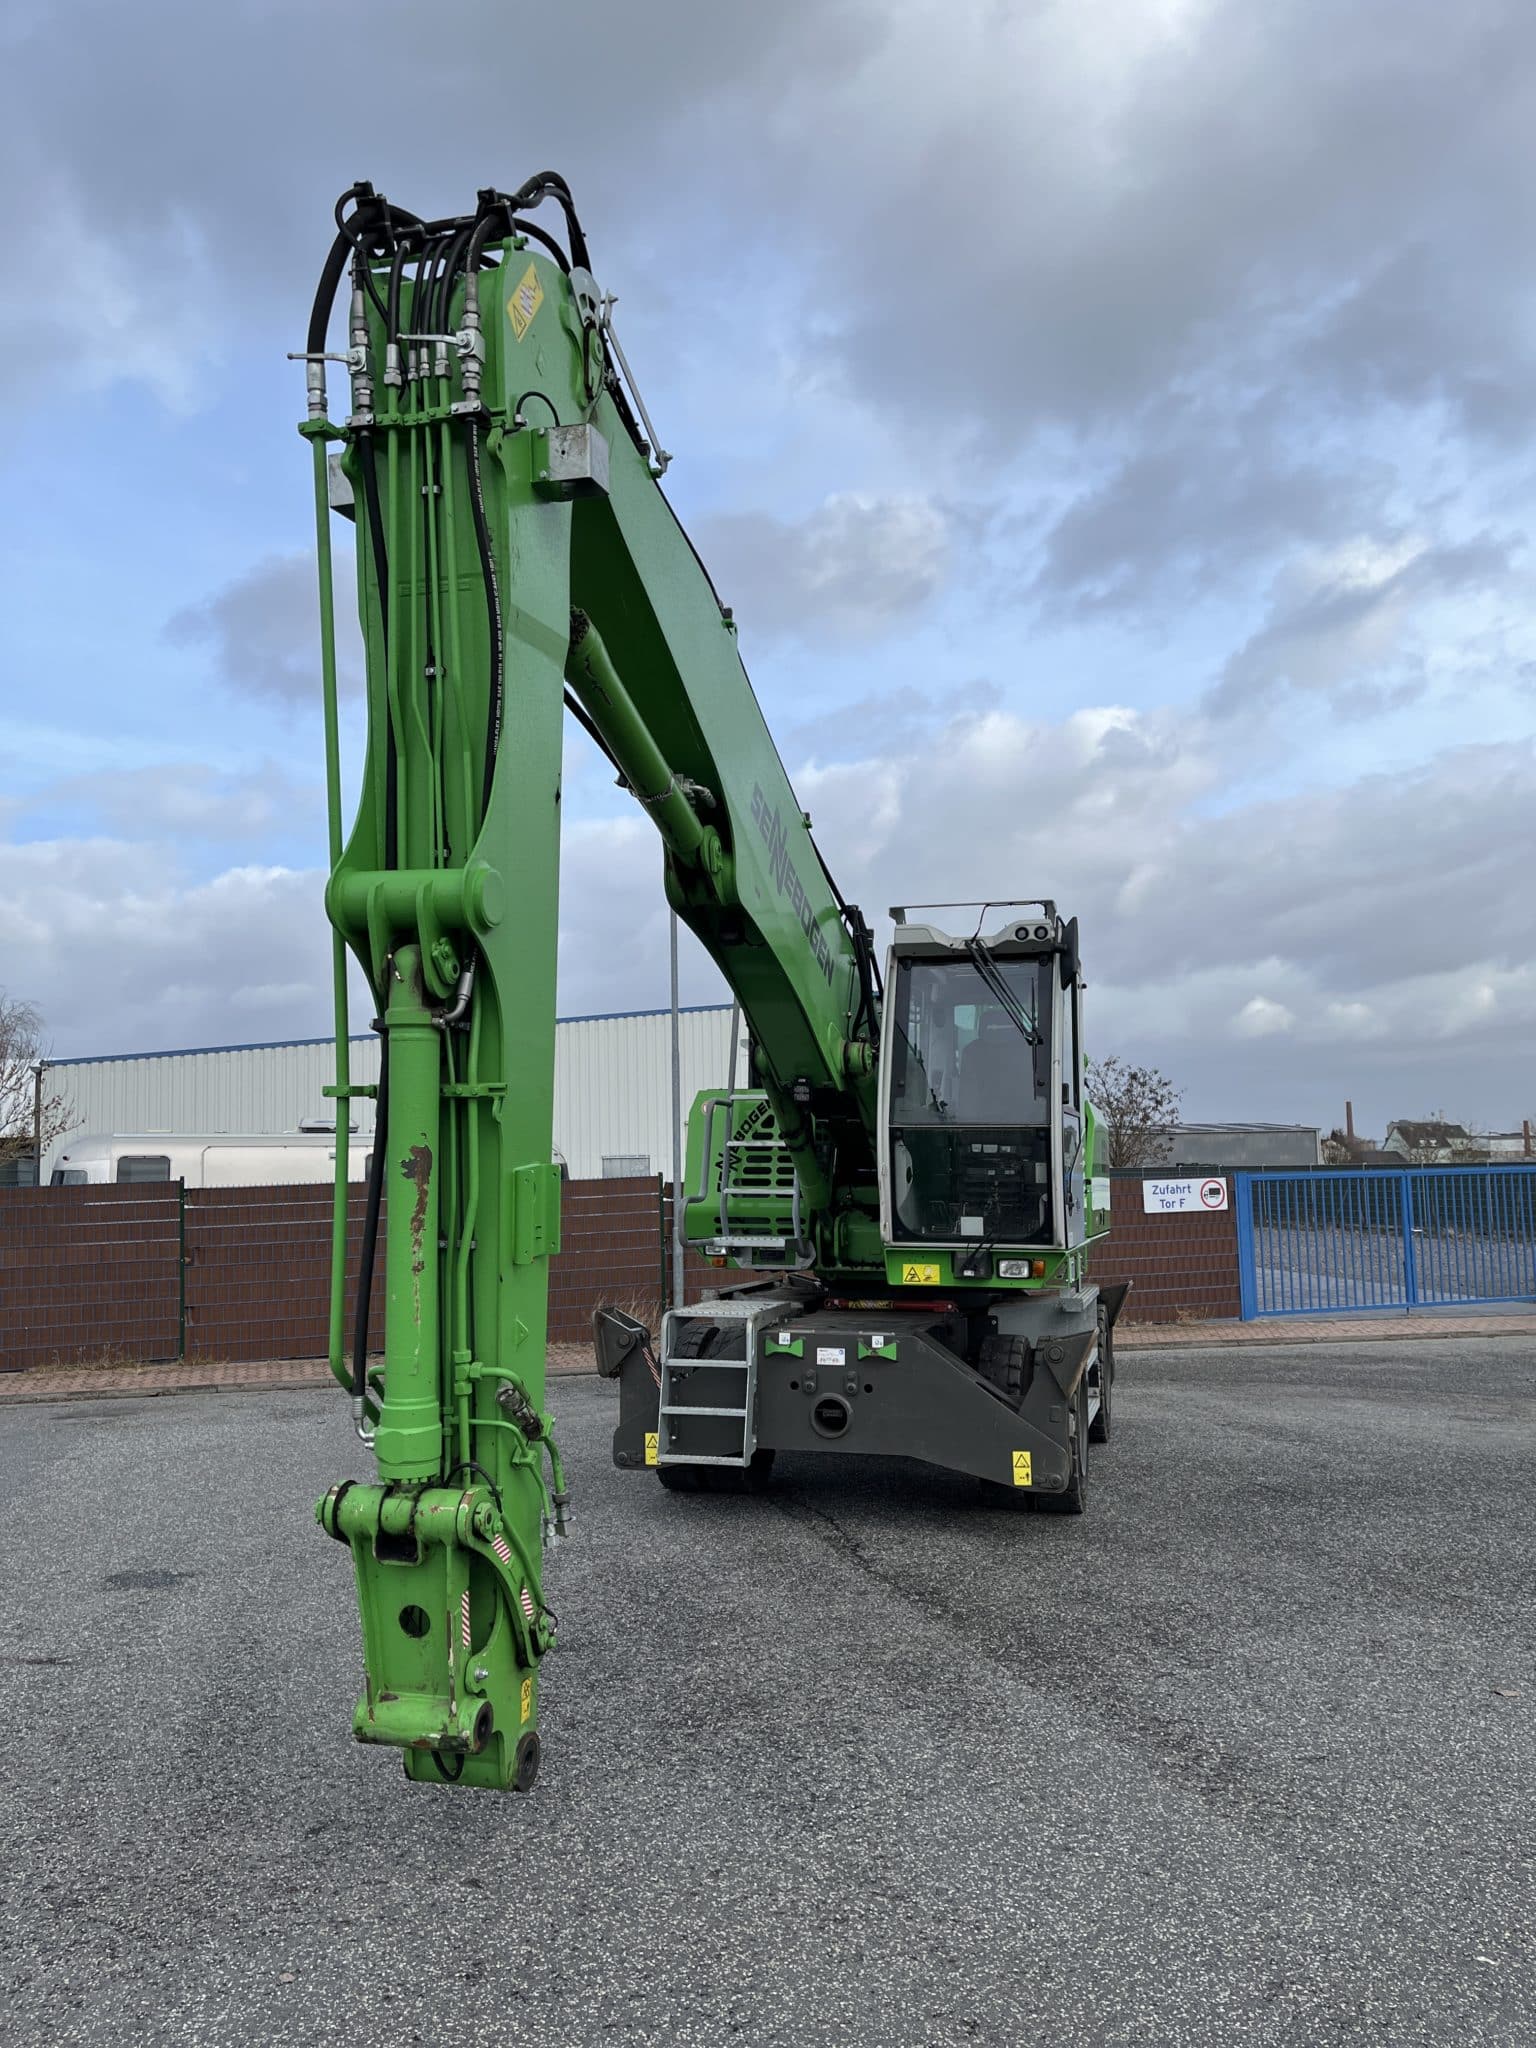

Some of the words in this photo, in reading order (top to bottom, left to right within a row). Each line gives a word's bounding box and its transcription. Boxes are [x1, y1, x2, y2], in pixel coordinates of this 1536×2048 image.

[750, 781, 835, 988] SENNEBOGEN
[1151, 1183, 1192, 1195] Zufahrt
[1159, 1198, 1177, 1209] Tor
[1179, 1198, 1186, 1208] F
